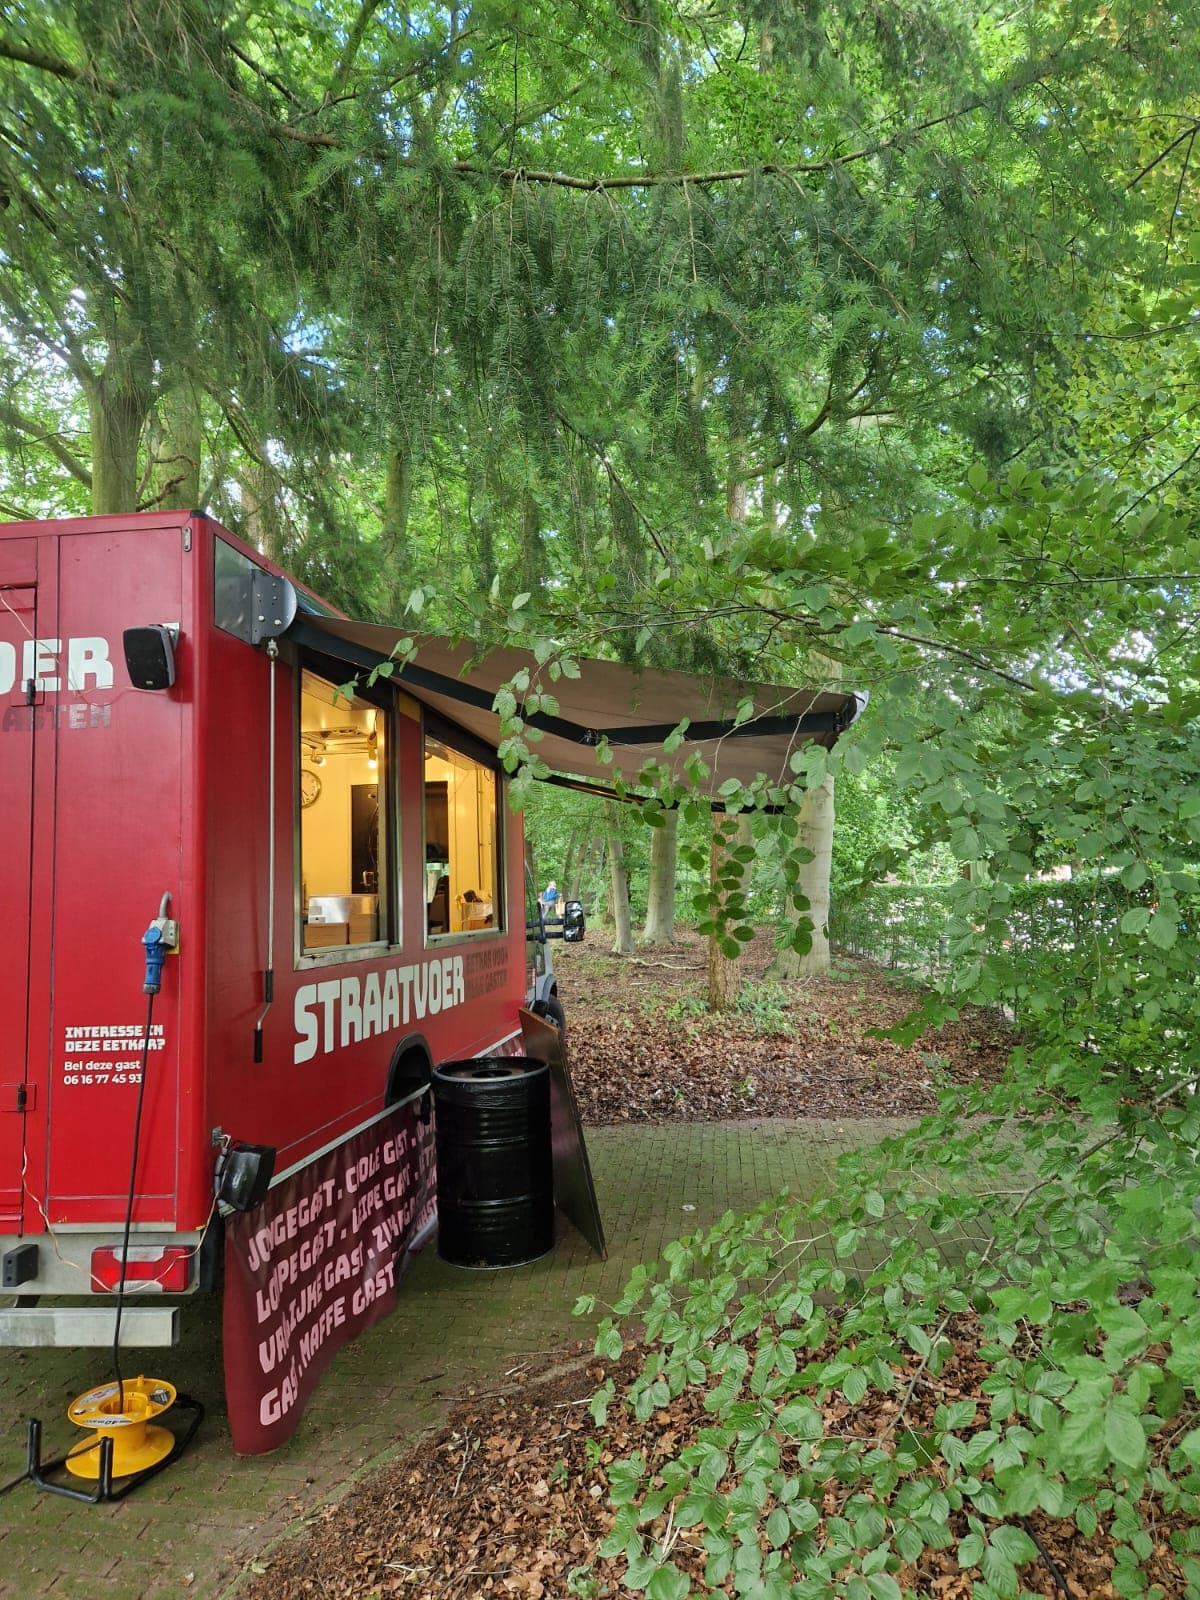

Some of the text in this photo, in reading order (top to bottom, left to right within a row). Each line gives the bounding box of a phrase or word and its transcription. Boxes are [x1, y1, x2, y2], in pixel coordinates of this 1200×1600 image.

[294, 955, 465, 1064] STRAATVOER
[65, 1025, 143, 1038] INTERESSE
[65, 1039, 165, 1052] DEZE EETKAR?
[64, 1060, 141, 1071] Bel deze gast
[64, 1073, 143, 1084] 06 16 77 45 93
[300, 1296, 346, 1368] MAFFE
[352, 1261, 395, 1315] GAST
